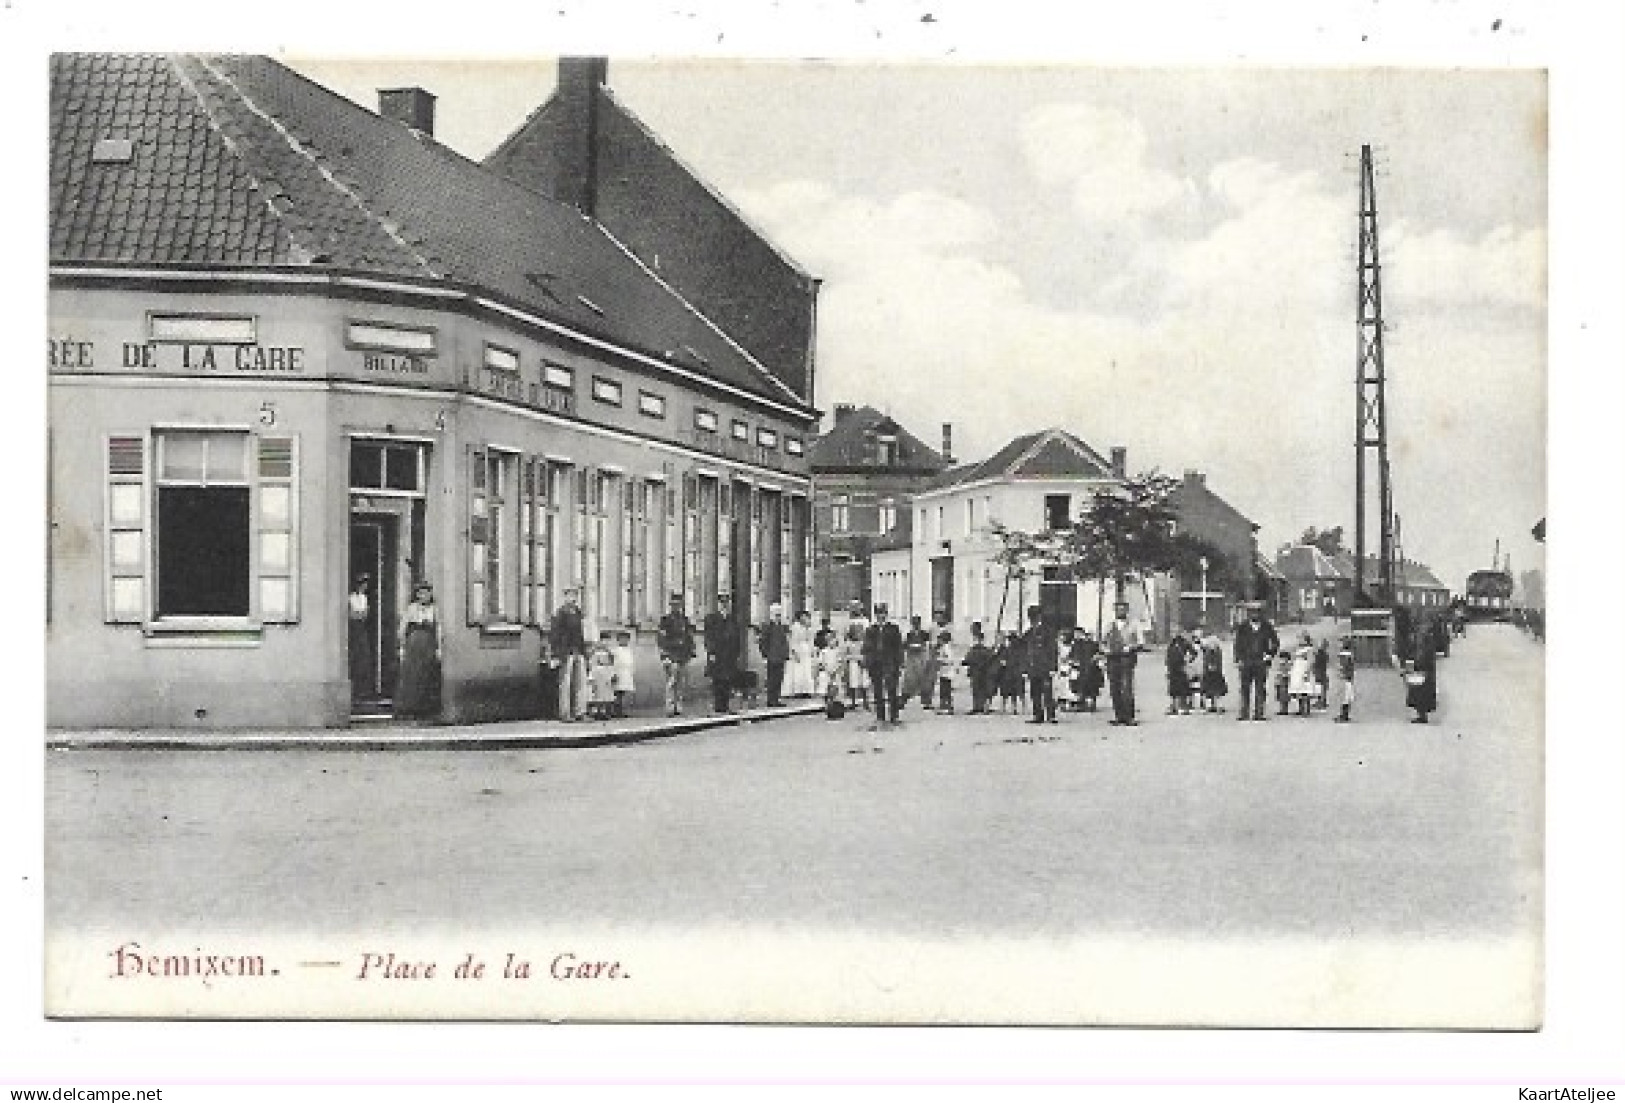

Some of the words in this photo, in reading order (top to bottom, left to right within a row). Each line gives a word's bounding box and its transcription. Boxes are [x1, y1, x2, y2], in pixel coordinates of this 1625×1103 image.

[122, 341, 157, 368] DE
[182, 344, 217, 371] LA
[259, 401, 275, 425] 5
[356, 952, 437, 980] Place
[455, 953, 486, 979] de
[503, 952, 531, 979] la
[550, 952, 632, 980] Gare.
